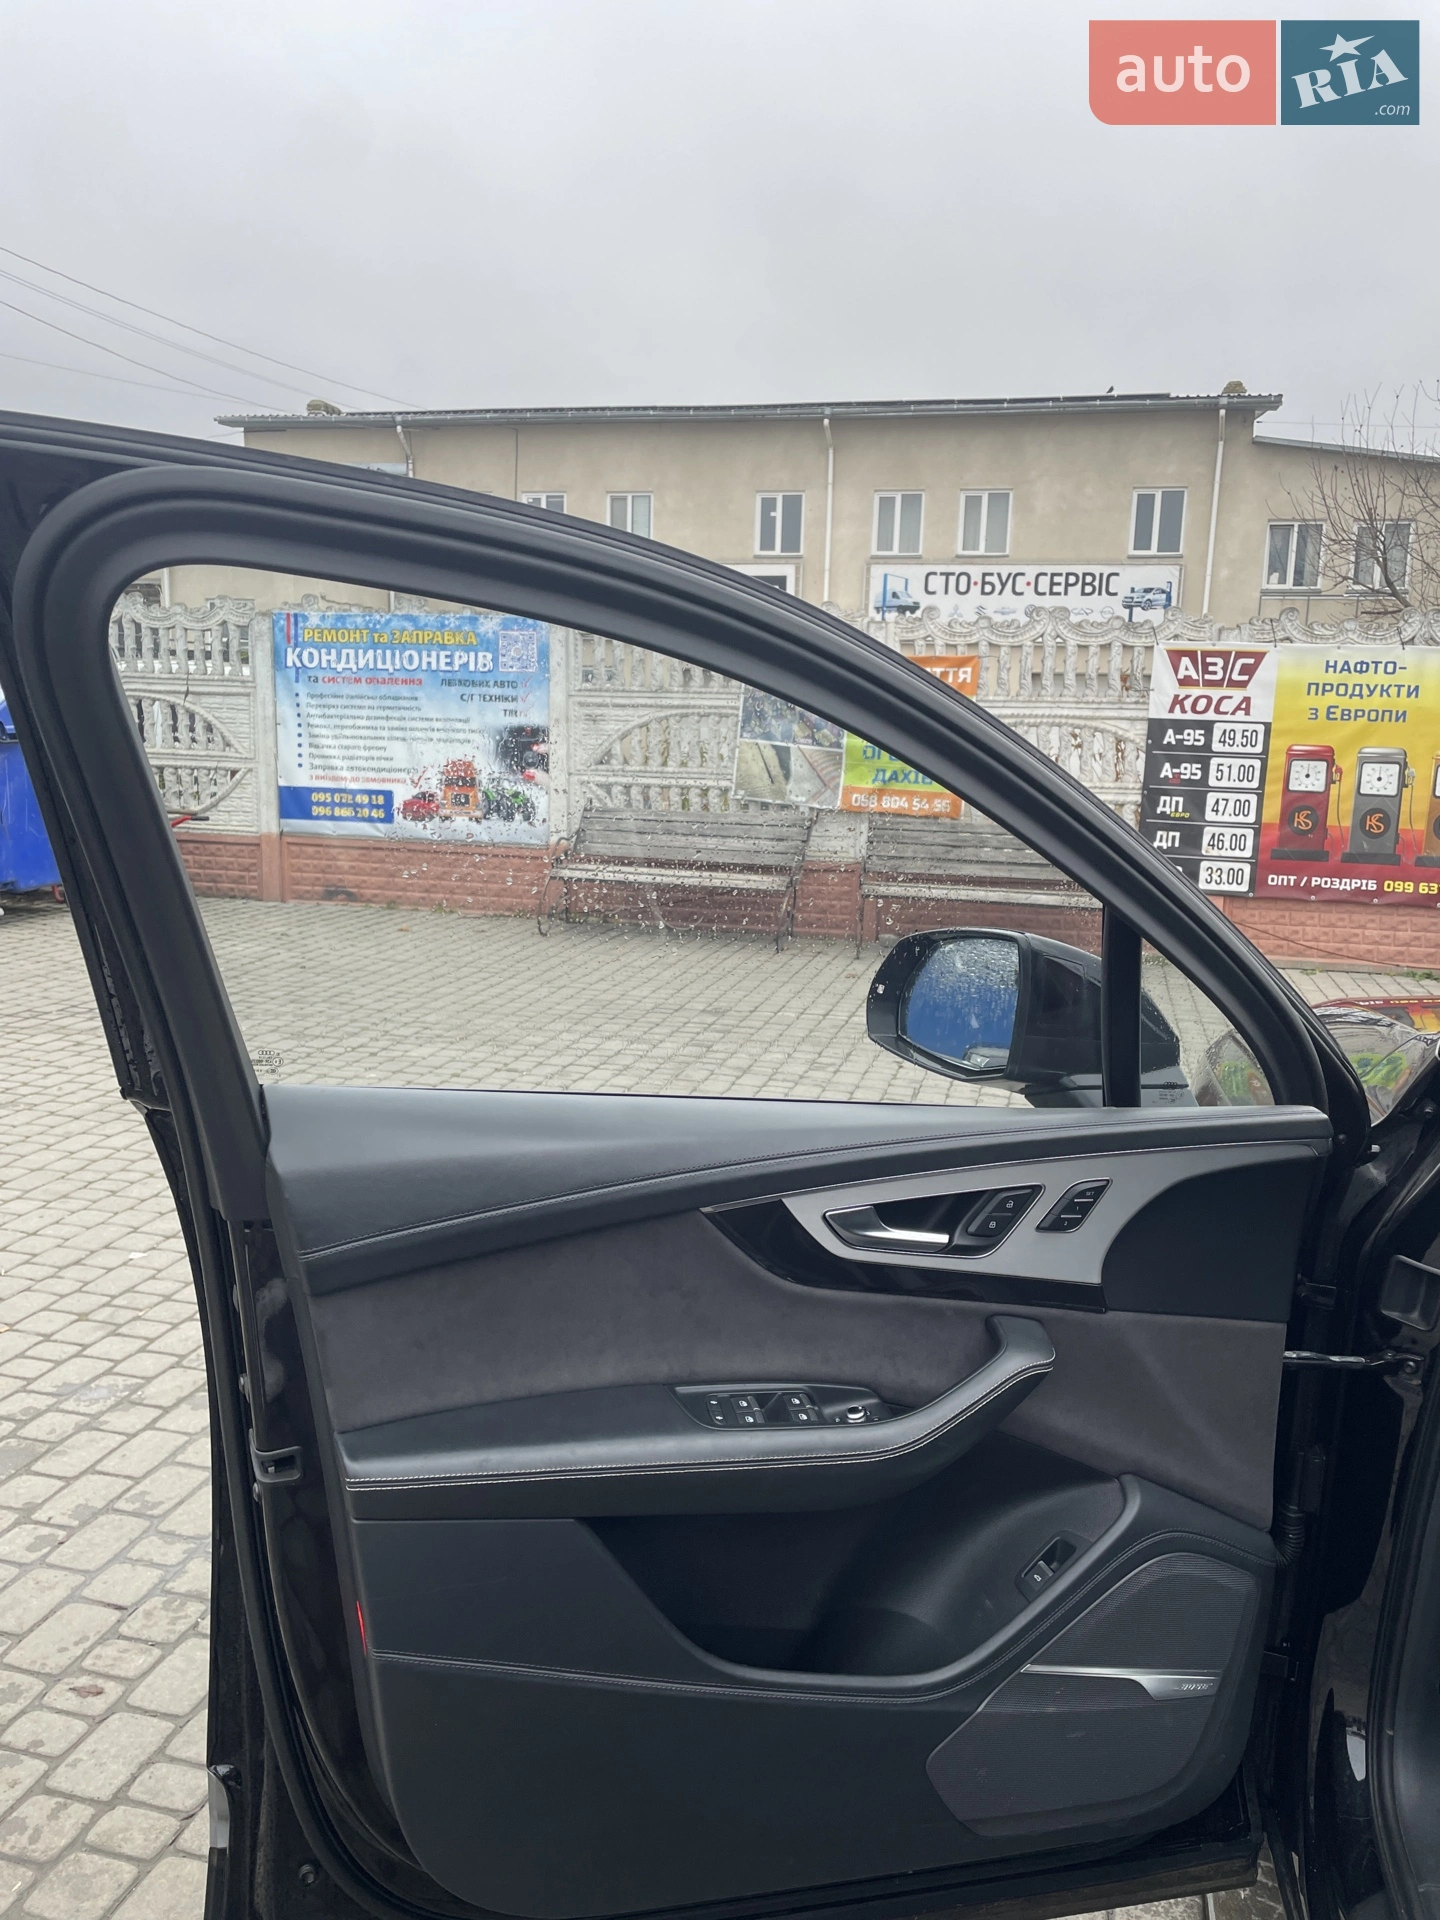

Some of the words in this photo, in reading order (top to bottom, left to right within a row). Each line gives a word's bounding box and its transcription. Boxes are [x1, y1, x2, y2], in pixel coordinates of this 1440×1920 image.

[923, 571, 971, 596] СТО
[1034, 572, 1120, 597] СЕРВІС
[303, 628, 369, 643] РЕМОНТ
[373, 633, 387, 644] та
[391, 629, 478, 645] ЗАПРАВКА
[285, 647, 494, 674] КОНДИЦІОНЕРІВ
[1176, 656, 1255, 681] АЗС
[1324, 659, 1408, 676] НАФТО-
[307, 676, 319, 684] та
[321, 676, 362, 685] систем
[365, 676, 423, 686] опалення
[493, 680, 518, 689] АВТО
[926, 667, 972, 683] ТТЯ
[1306, 681, 1421, 700] ПРОДУКТИ
[1168, 694, 1252, 717] КОСА
[1218, 729, 1258, 748] 49.50
[1215, 763, 1256, 783] 51.00
[311, 791, 332, 803] 095
[355, 793, 370, 804] 49
[371, 794, 385, 805] 18
[1157, 795, 1183, 815] ДП
[1210, 797, 1251, 817] 47.00
[311, 805, 332, 816] 096
[1153, 830, 1181, 850] ДП
[1207, 832, 1247, 852] 46.00
[1204, 866, 1245, 886] 33.00
[1267, 874, 1297, 887] ОПТ
[1311, 876, 1378, 891] РОЗДРІБ
[1383, 880, 1414, 893] 099
[1418, 882, 1440, 895] 63
